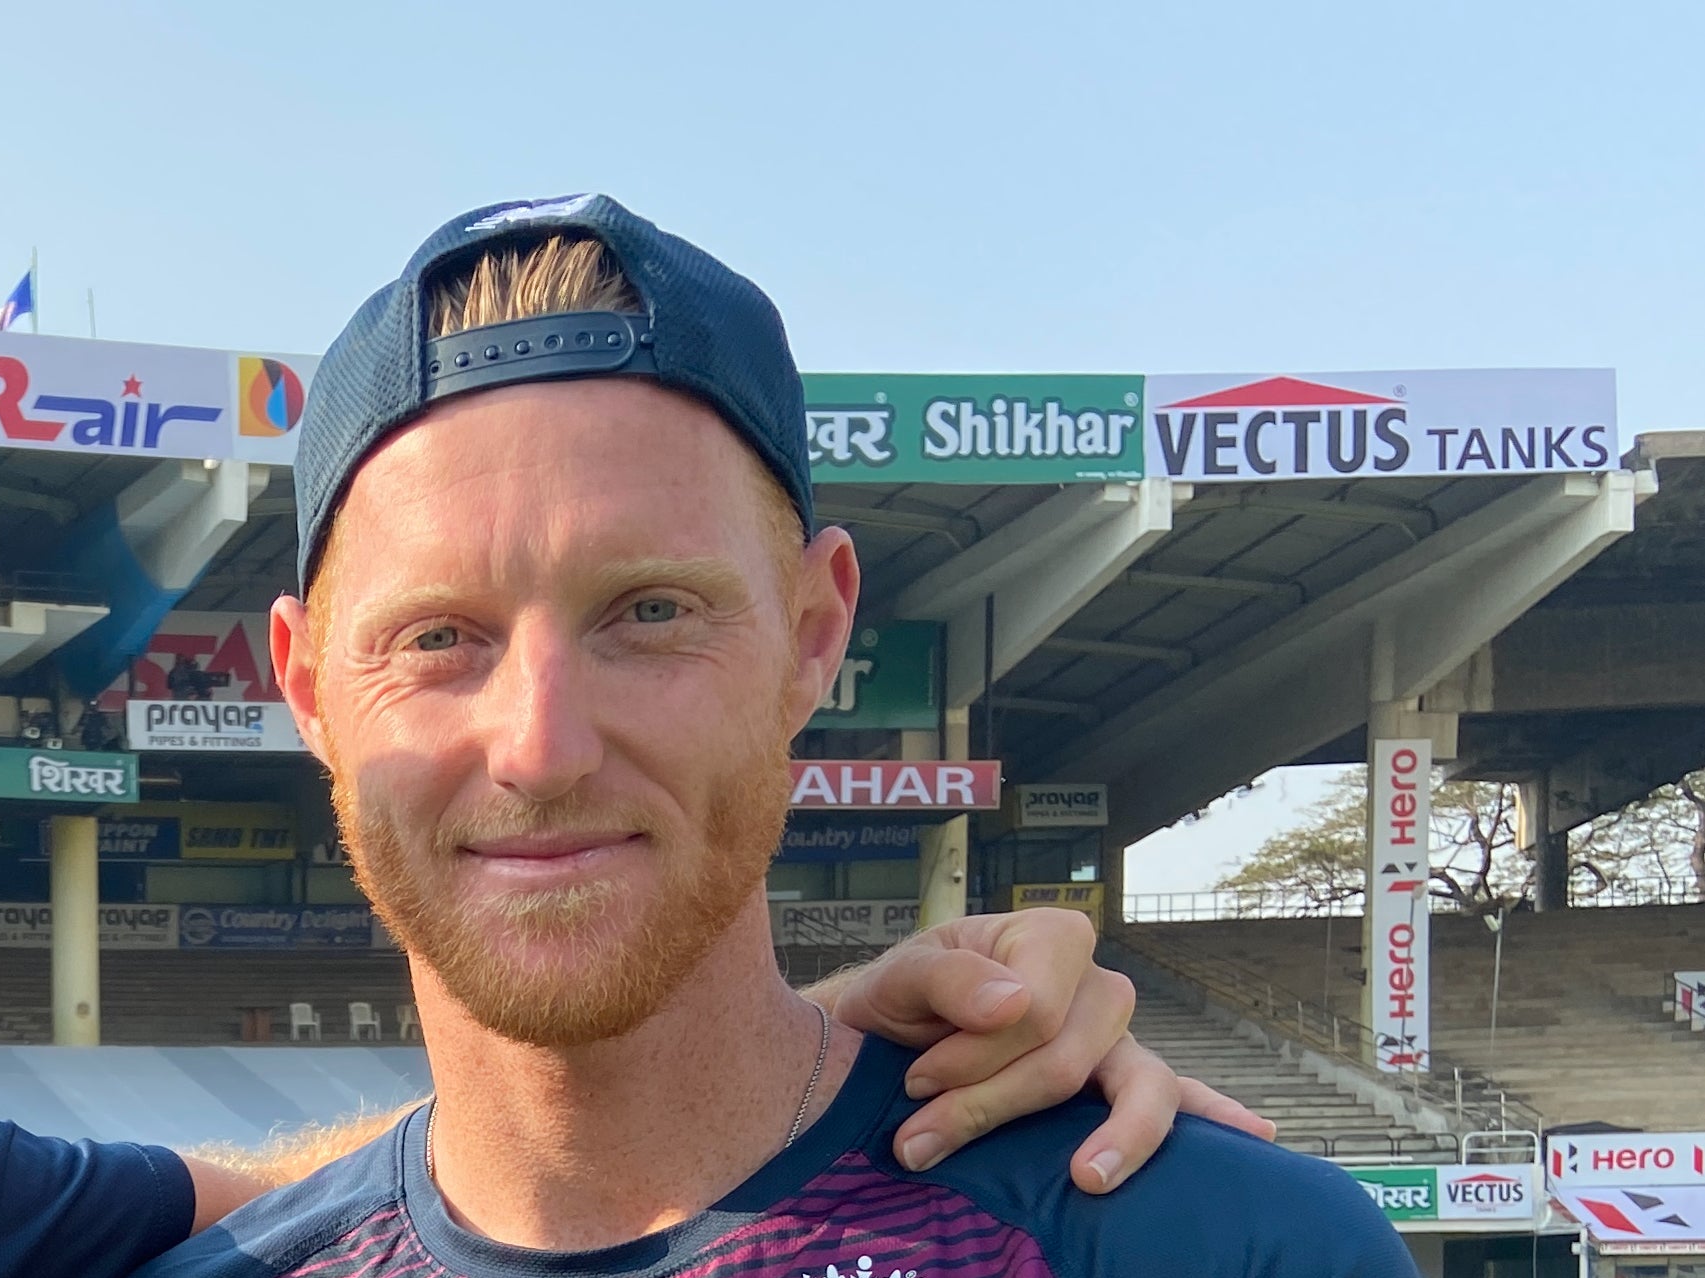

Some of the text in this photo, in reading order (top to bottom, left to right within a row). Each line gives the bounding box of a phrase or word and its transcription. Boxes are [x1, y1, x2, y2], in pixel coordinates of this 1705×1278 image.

[33, 374, 223, 448] air
[924, 399, 1135, 457] Shikhar
[1154, 408, 1609, 475] VECTUS TANKS
[147, 704, 263, 733] prayag
[148, 736, 262, 747] PIPES & FITTINGS
[790, 765, 976, 805] AHAR
[1389, 748, 1418, 845] Hero
[1387, 923, 1415, 1019] Hero
[1593, 1148, 1675, 1170] Hero
[1447, 1183, 1523, 1203] VECTUS
